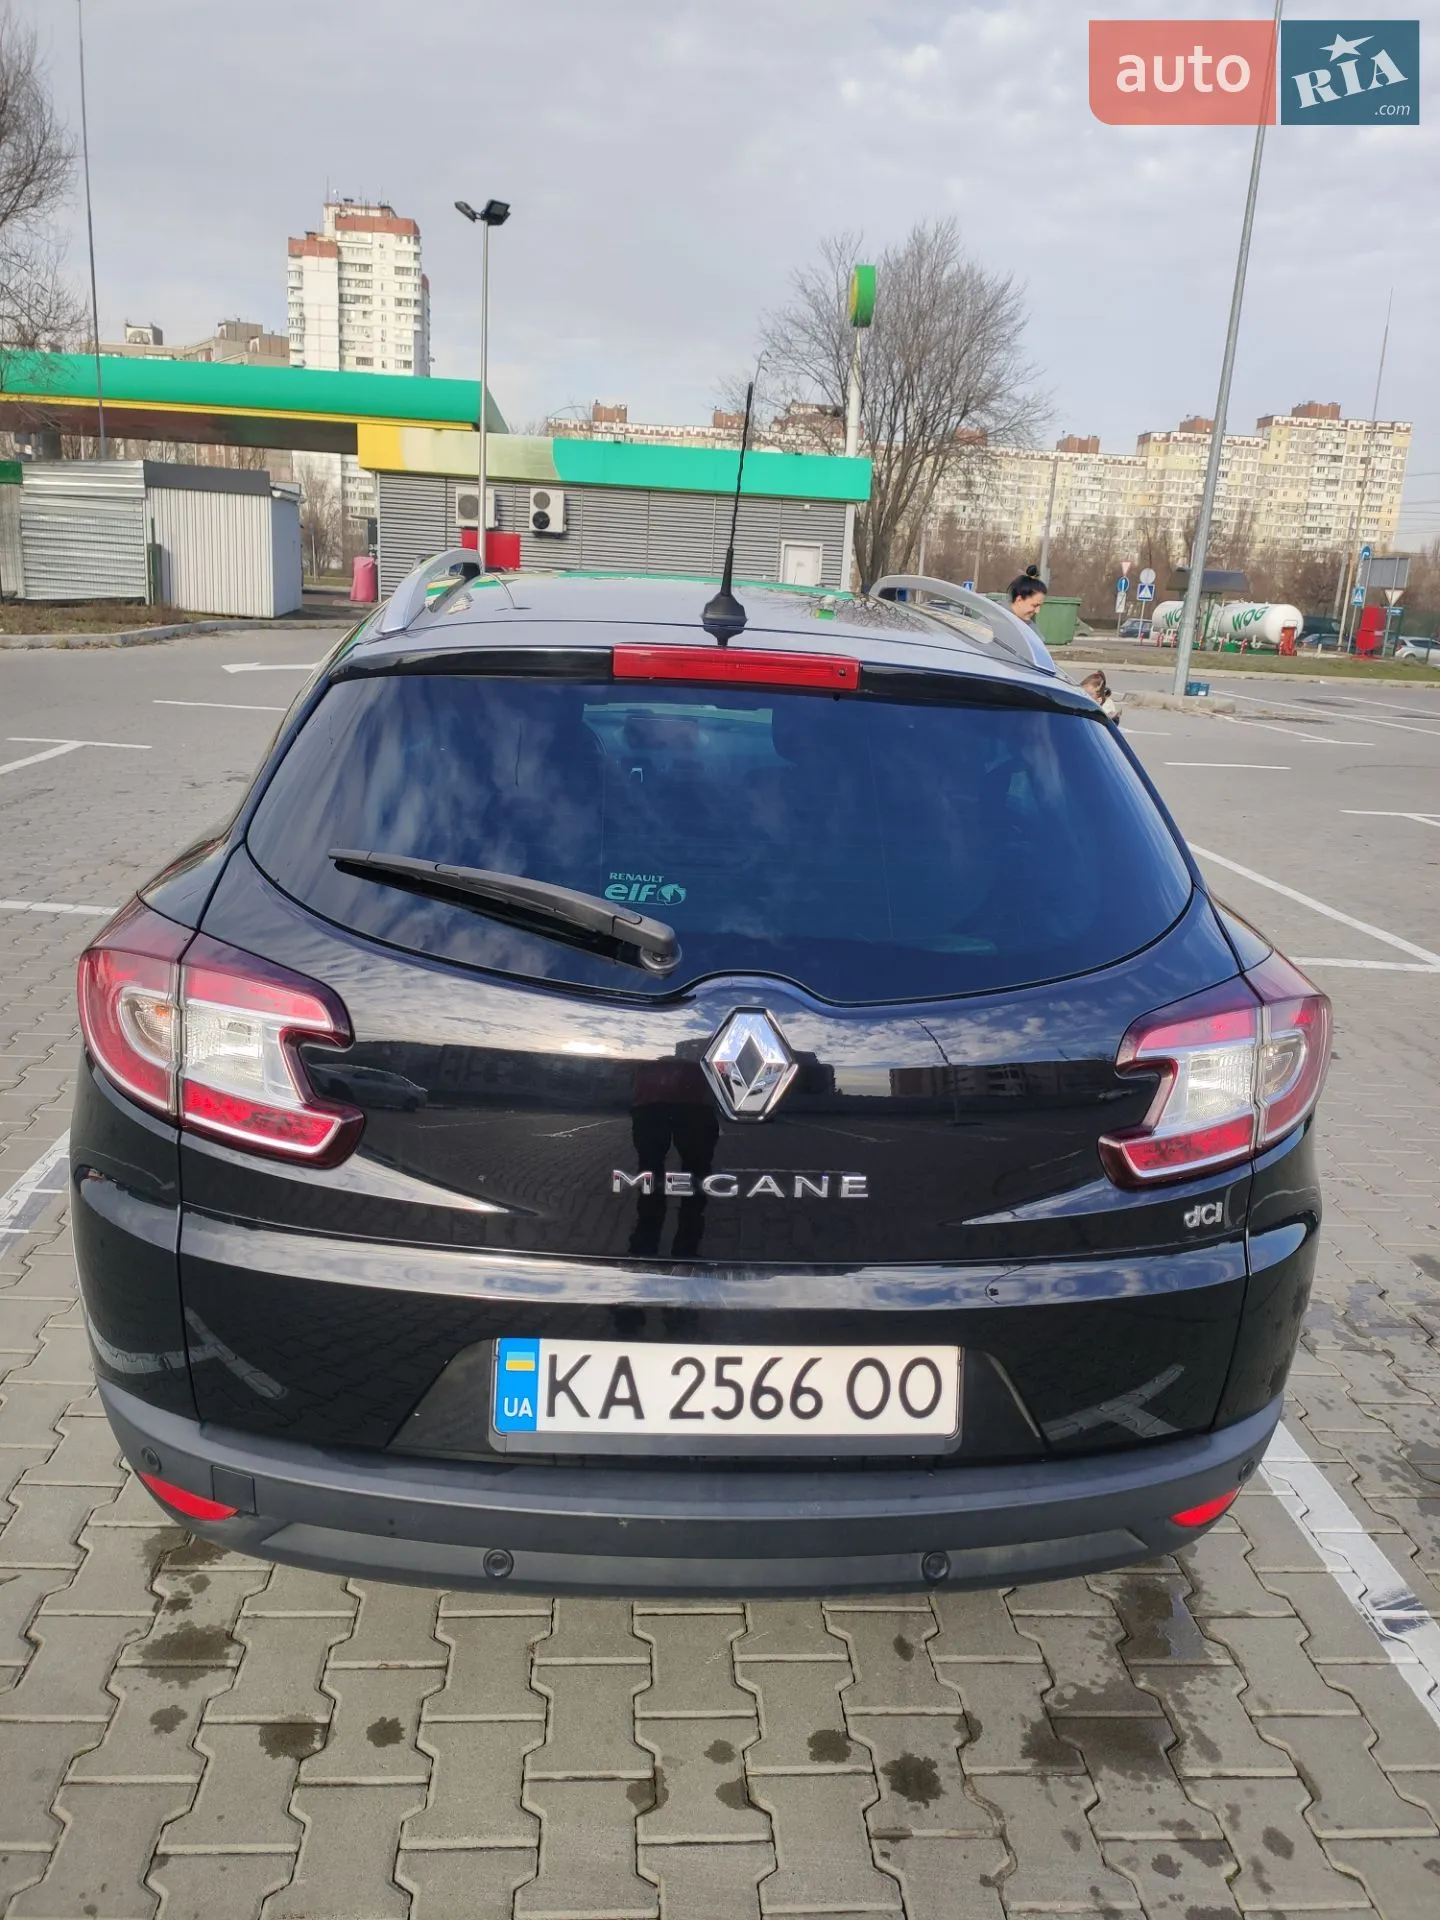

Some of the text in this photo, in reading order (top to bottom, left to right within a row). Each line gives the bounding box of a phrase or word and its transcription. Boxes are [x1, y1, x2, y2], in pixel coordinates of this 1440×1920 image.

[1232, 605, 1270, 632] WOG
[609, 872, 665, 883] RENAULT
[604, 883, 657, 902] elf
[612, 1169, 869, 1198] MEGANE
[545, 1354, 645, 1420] KA
[668, 1356, 824, 1420] 2566
[503, 1396, 533, 1418] UA
